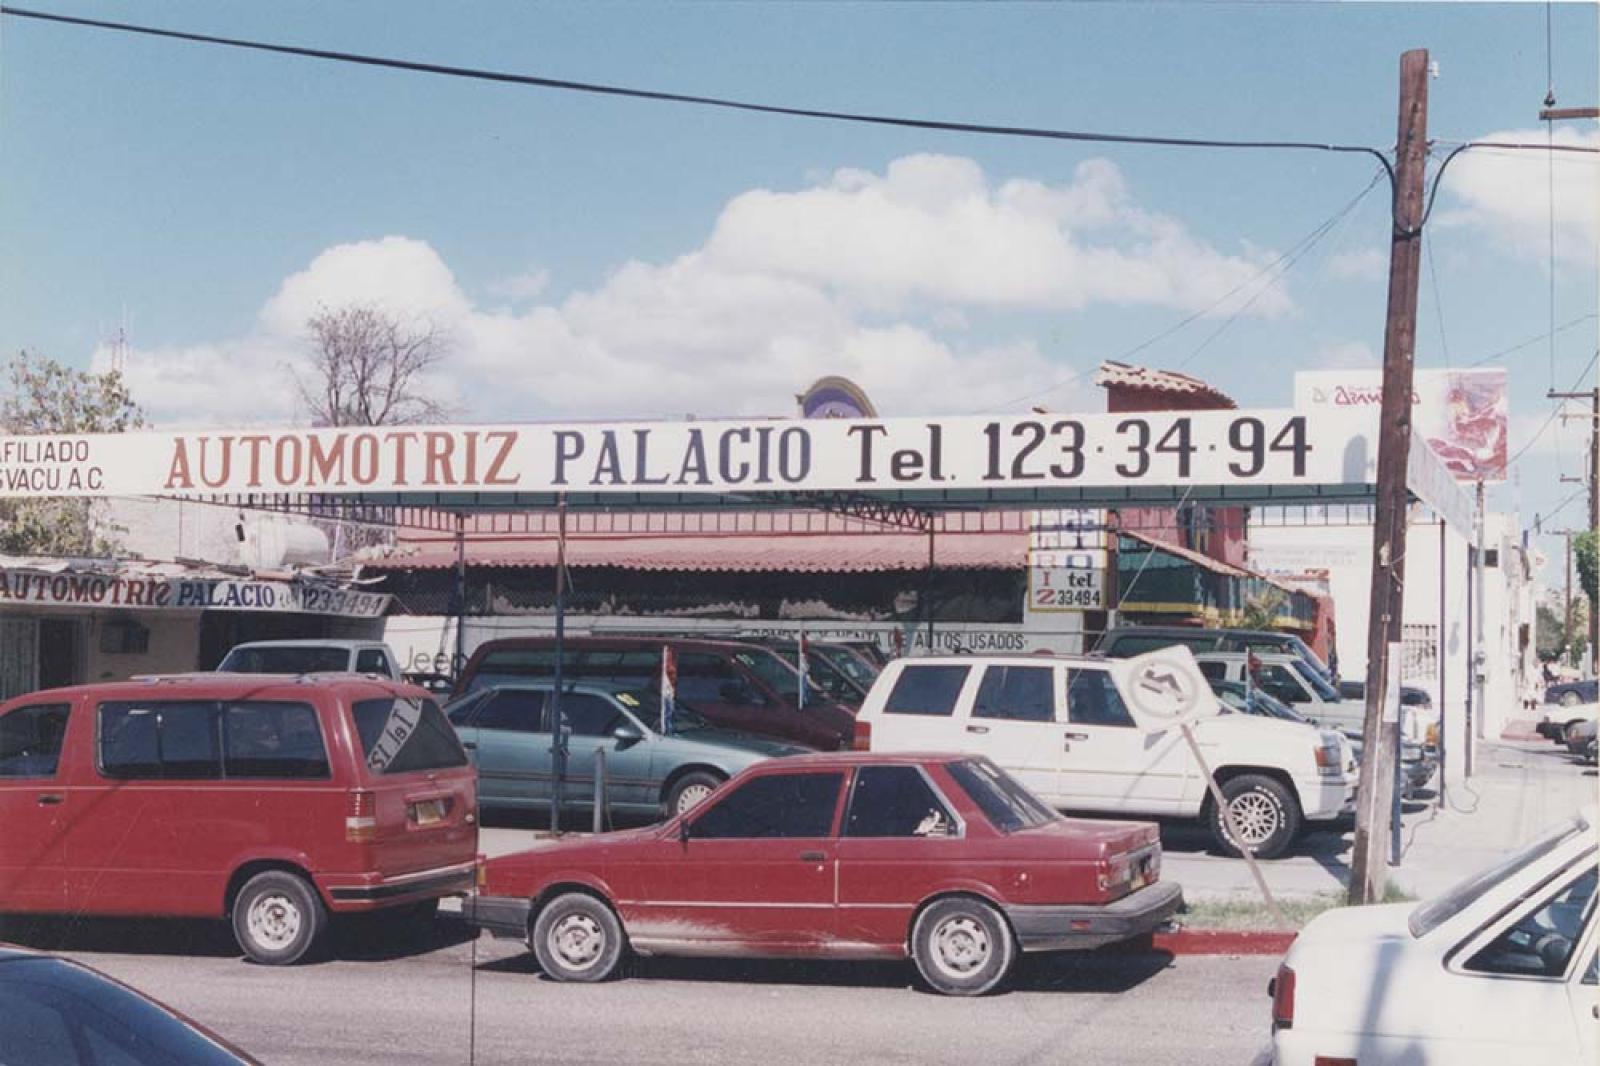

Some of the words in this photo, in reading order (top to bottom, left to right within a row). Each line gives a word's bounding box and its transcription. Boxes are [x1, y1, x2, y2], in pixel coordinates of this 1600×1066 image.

[0, 440, 89, 462] FILIADO
[164, 431, 521, 488] AUTOMOTRIZ
[550, 426, 811, 485] PALACIO
[847, 424, 956, 482] Tel.
[177, 582, 275, 607] PALACIO
[1058, 589, 1100, 605] 33494
